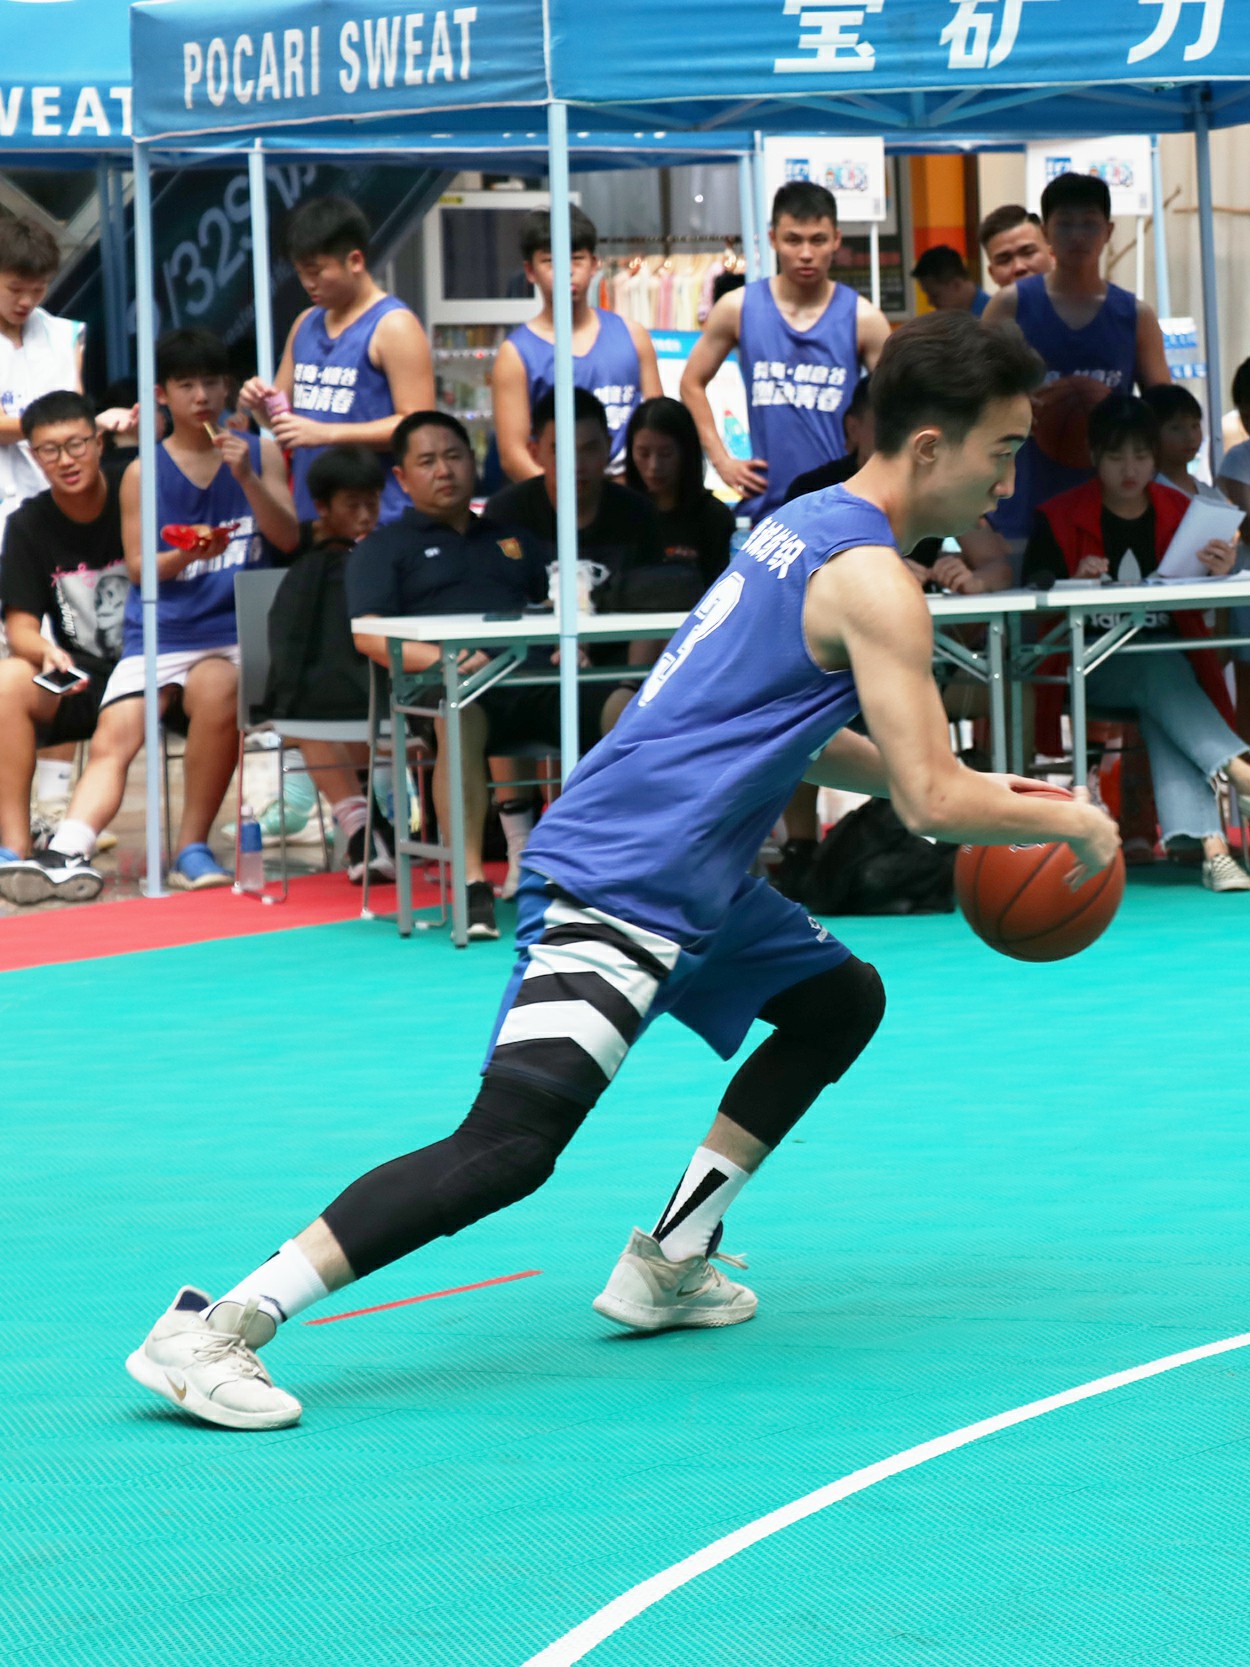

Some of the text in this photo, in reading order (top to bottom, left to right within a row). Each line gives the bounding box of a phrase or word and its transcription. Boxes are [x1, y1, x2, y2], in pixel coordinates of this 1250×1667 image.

[183, 7, 478, 110] POCARI SWEAT
[637, 570, 746, 708] 3
